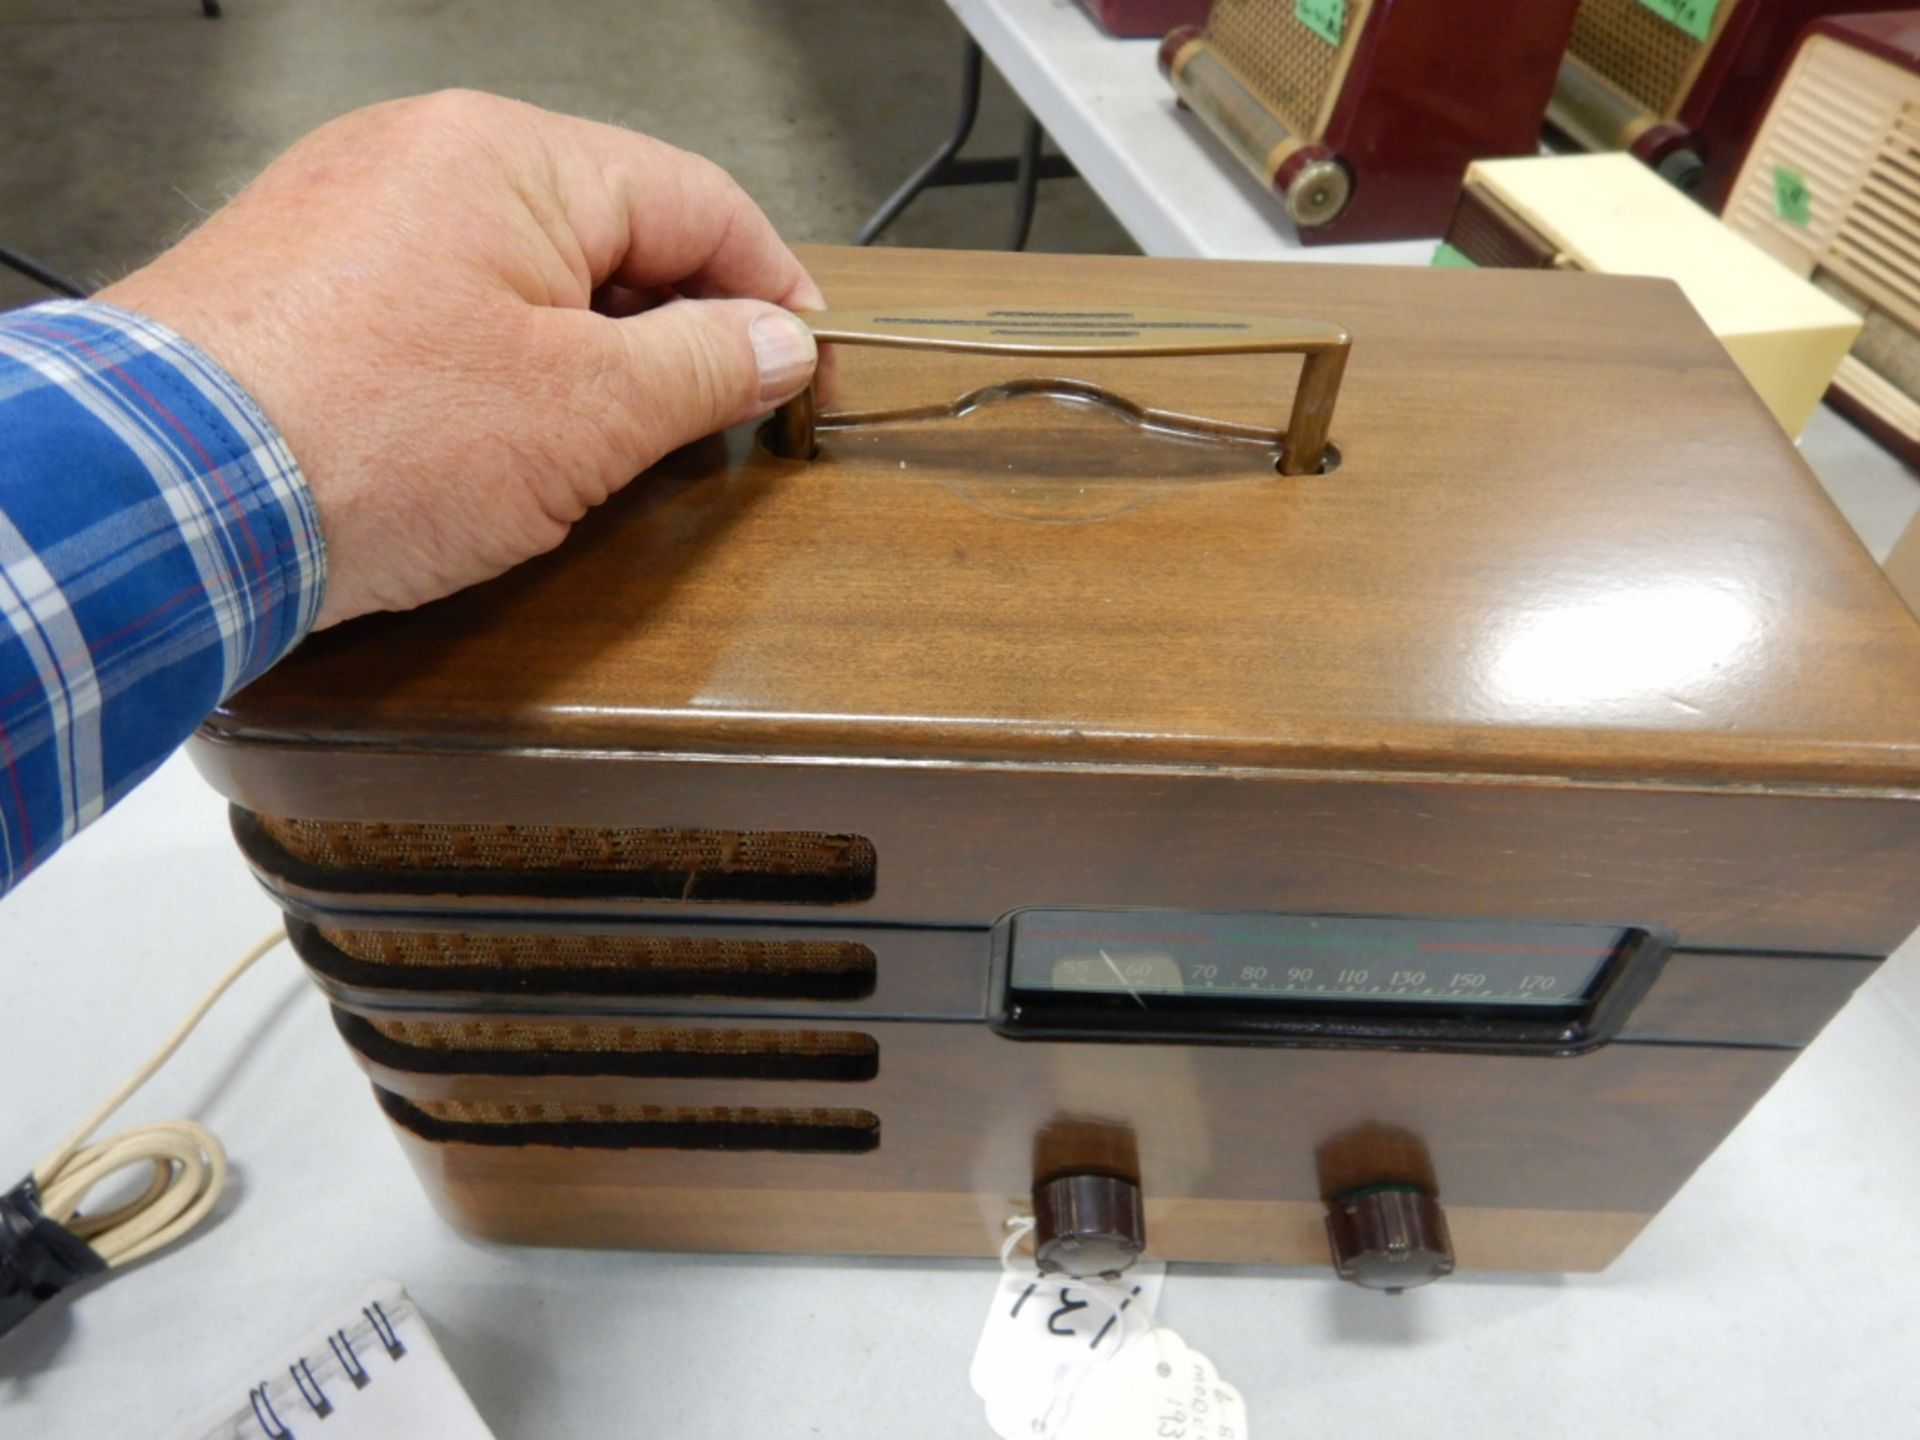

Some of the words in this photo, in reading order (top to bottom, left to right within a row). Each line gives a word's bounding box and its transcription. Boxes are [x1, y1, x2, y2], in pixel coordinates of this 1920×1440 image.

[1124, 962, 1153, 977] 60
[1191, 964, 1218, 979] 70
[1240, 966, 1268, 981] 80
[1287, 967, 1314, 982] 90
[1337, 969, 1369, 985] 110
[1389, 971, 1426, 987] 130
[1450, 972, 1486, 988] 150
[1518, 974, 1556, 991] 170
